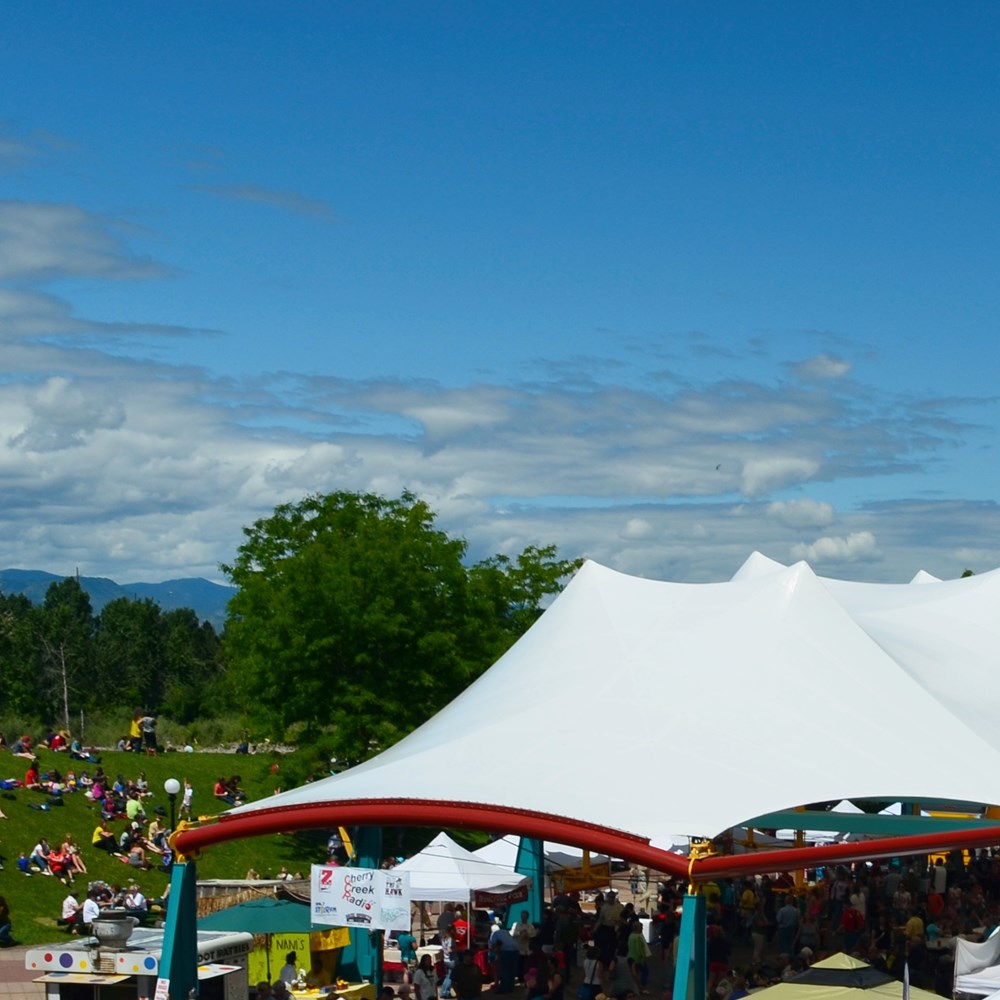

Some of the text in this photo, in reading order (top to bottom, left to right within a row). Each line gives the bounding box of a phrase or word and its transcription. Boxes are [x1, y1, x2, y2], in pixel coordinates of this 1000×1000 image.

[344, 871, 374, 886] Cherry
[344, 883, 375, 895] Creek
[342, 891, 372, 911] Radio
